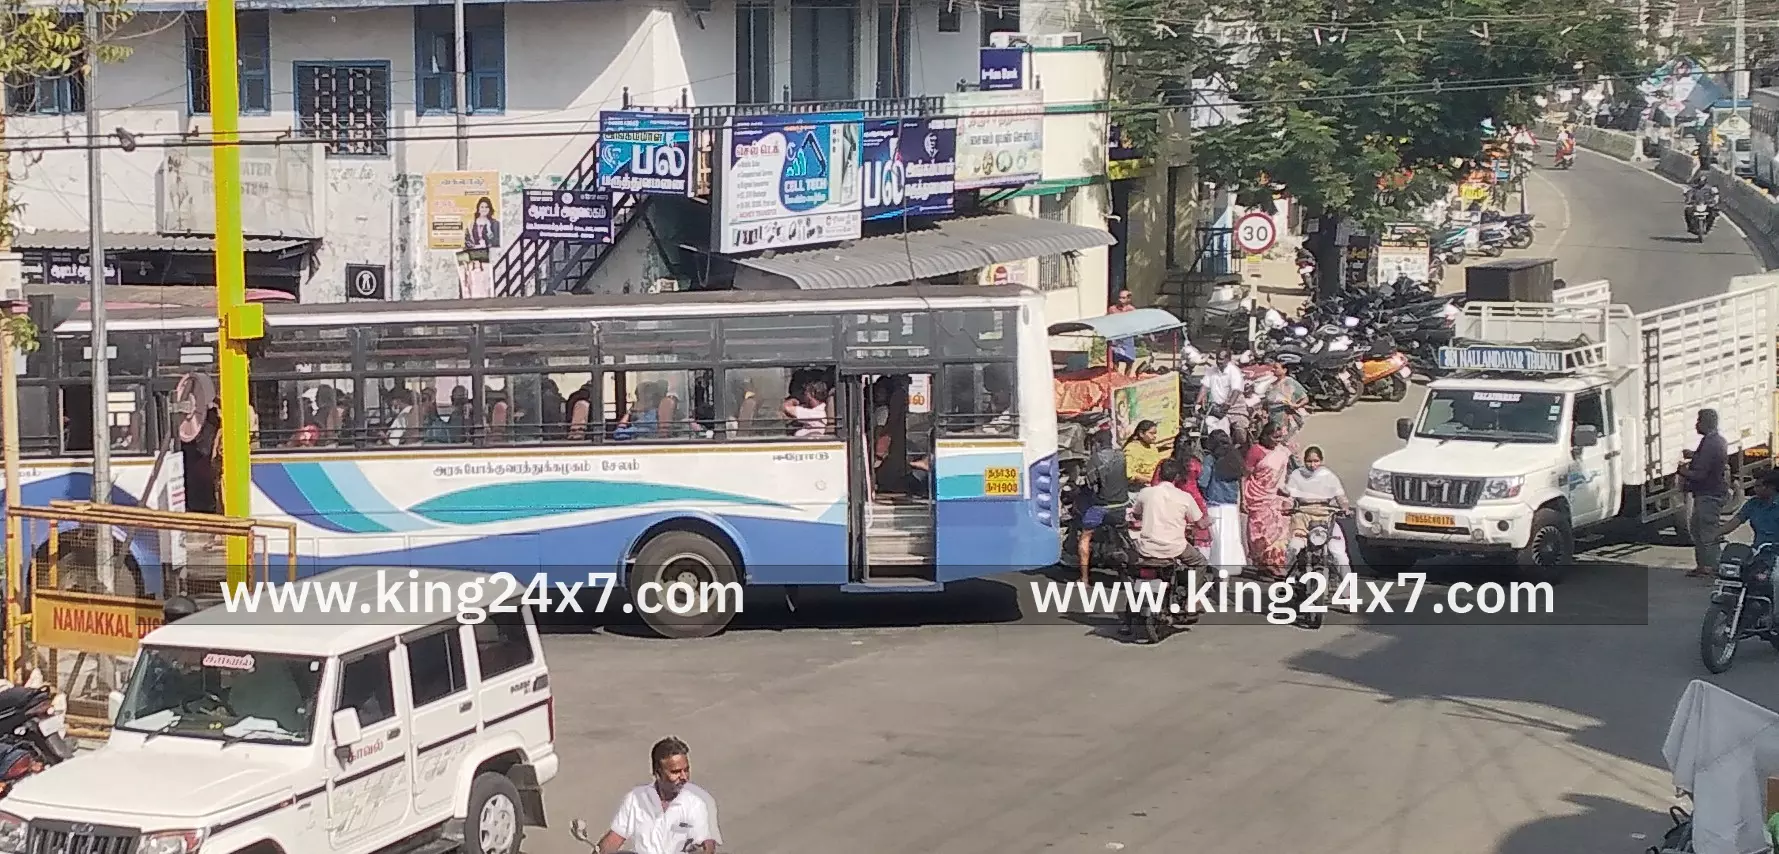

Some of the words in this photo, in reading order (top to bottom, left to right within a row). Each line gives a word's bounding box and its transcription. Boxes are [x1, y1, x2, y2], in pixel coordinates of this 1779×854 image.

[1243, 226, 1268, 241] 30
[1526, 352, 1560, 371] THUNAI
[601, 458, 640, 472] சேலம்
[53, 606, 134, 639] NAMAKKAL
